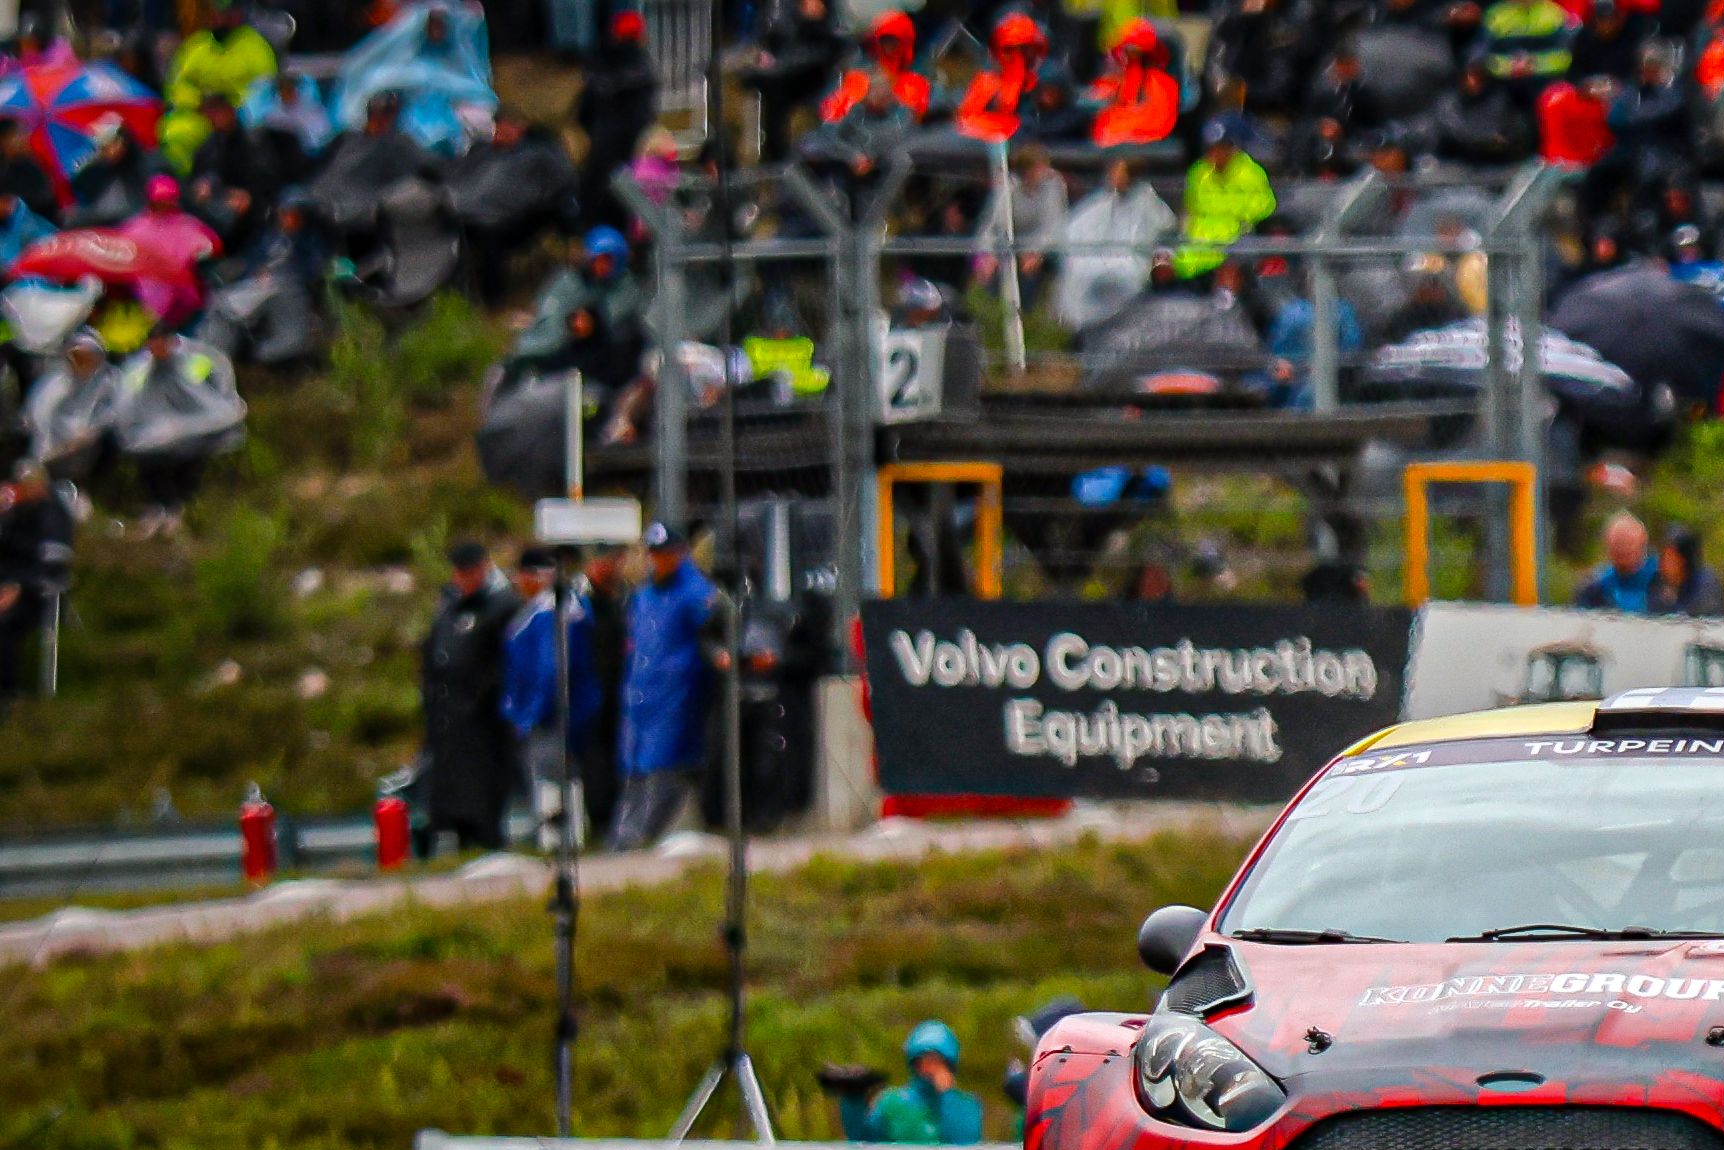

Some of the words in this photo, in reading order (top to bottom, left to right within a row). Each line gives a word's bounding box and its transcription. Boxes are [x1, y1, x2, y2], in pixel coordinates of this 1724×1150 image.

[887, 346, 920, 409] 2
[890, 628, 1041, 688] Volvo
[1045, 631, 1378, 701] Construction
[1005, 698, 1283, 770] Equipment
[1344, 750, 1433, 774] RX1
[1606, 1000, 1643, 1014] Oy
